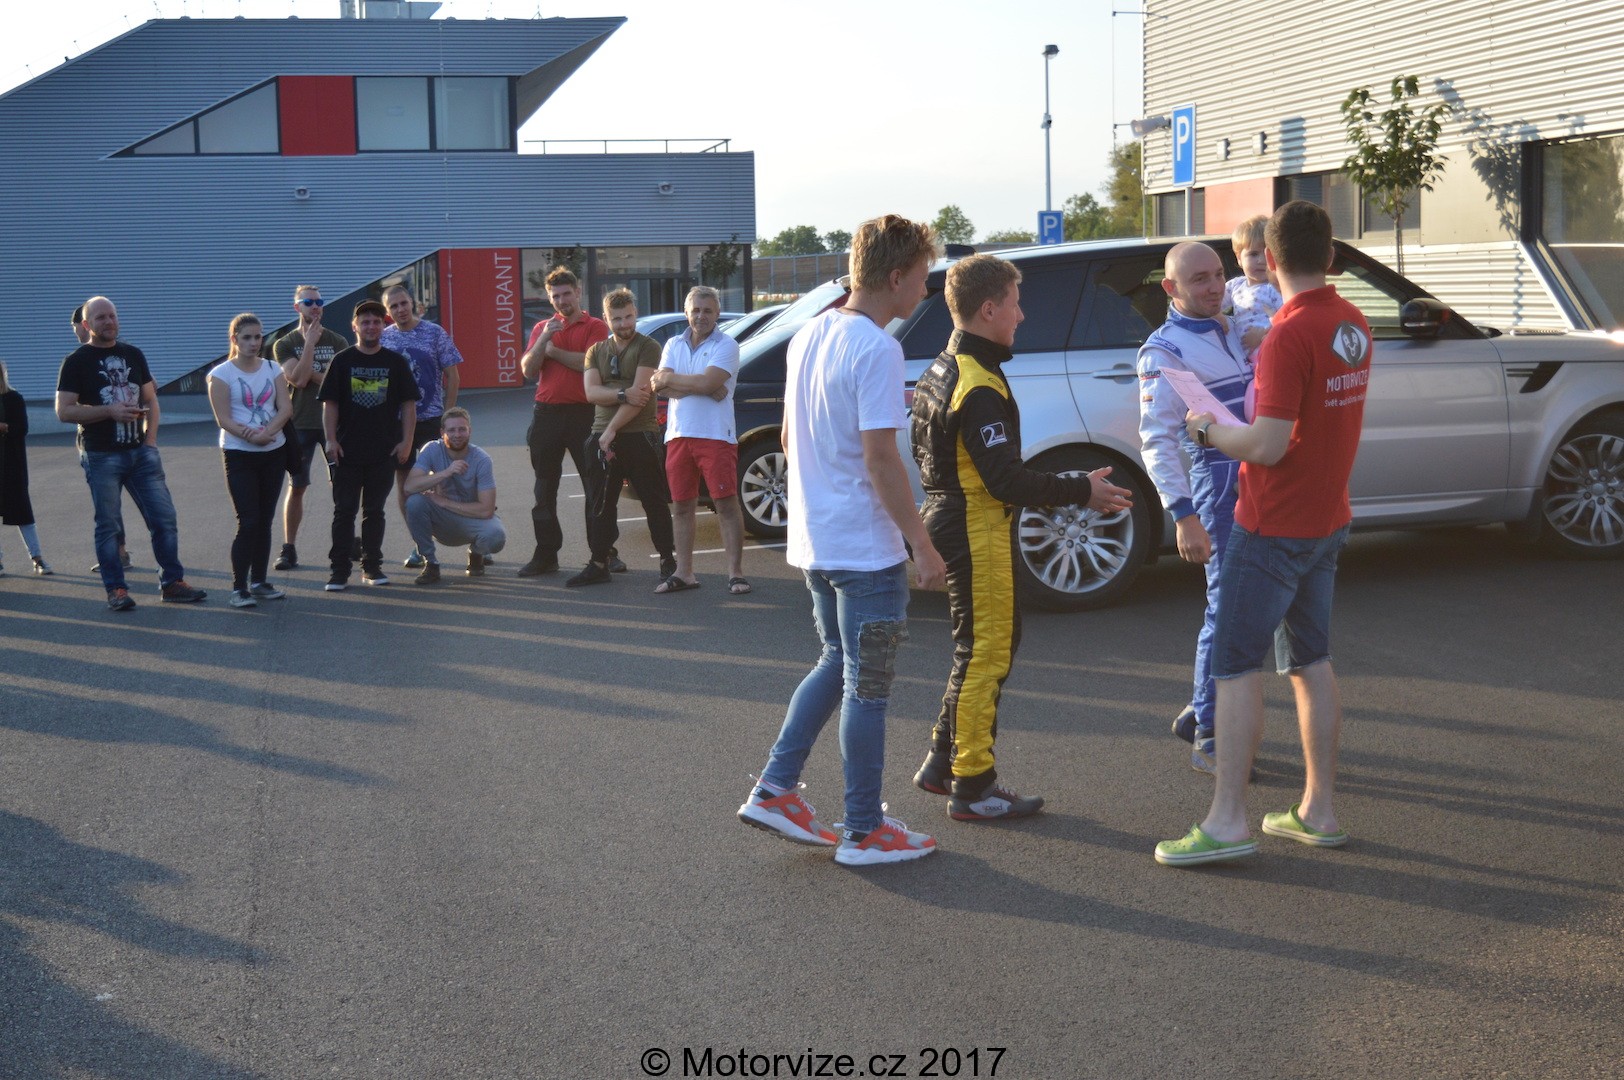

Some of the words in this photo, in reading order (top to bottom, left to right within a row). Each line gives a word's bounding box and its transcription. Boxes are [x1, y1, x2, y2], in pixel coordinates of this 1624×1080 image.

[1176, 115, 1190, 161] P
[1043, 215, 1058, 236] P
[494, 252, 517, 383] RESTAURANT
[351, 367, 390, 377] MEATFLY
[1326, 369, 1368, 393] MOTORVIZE
